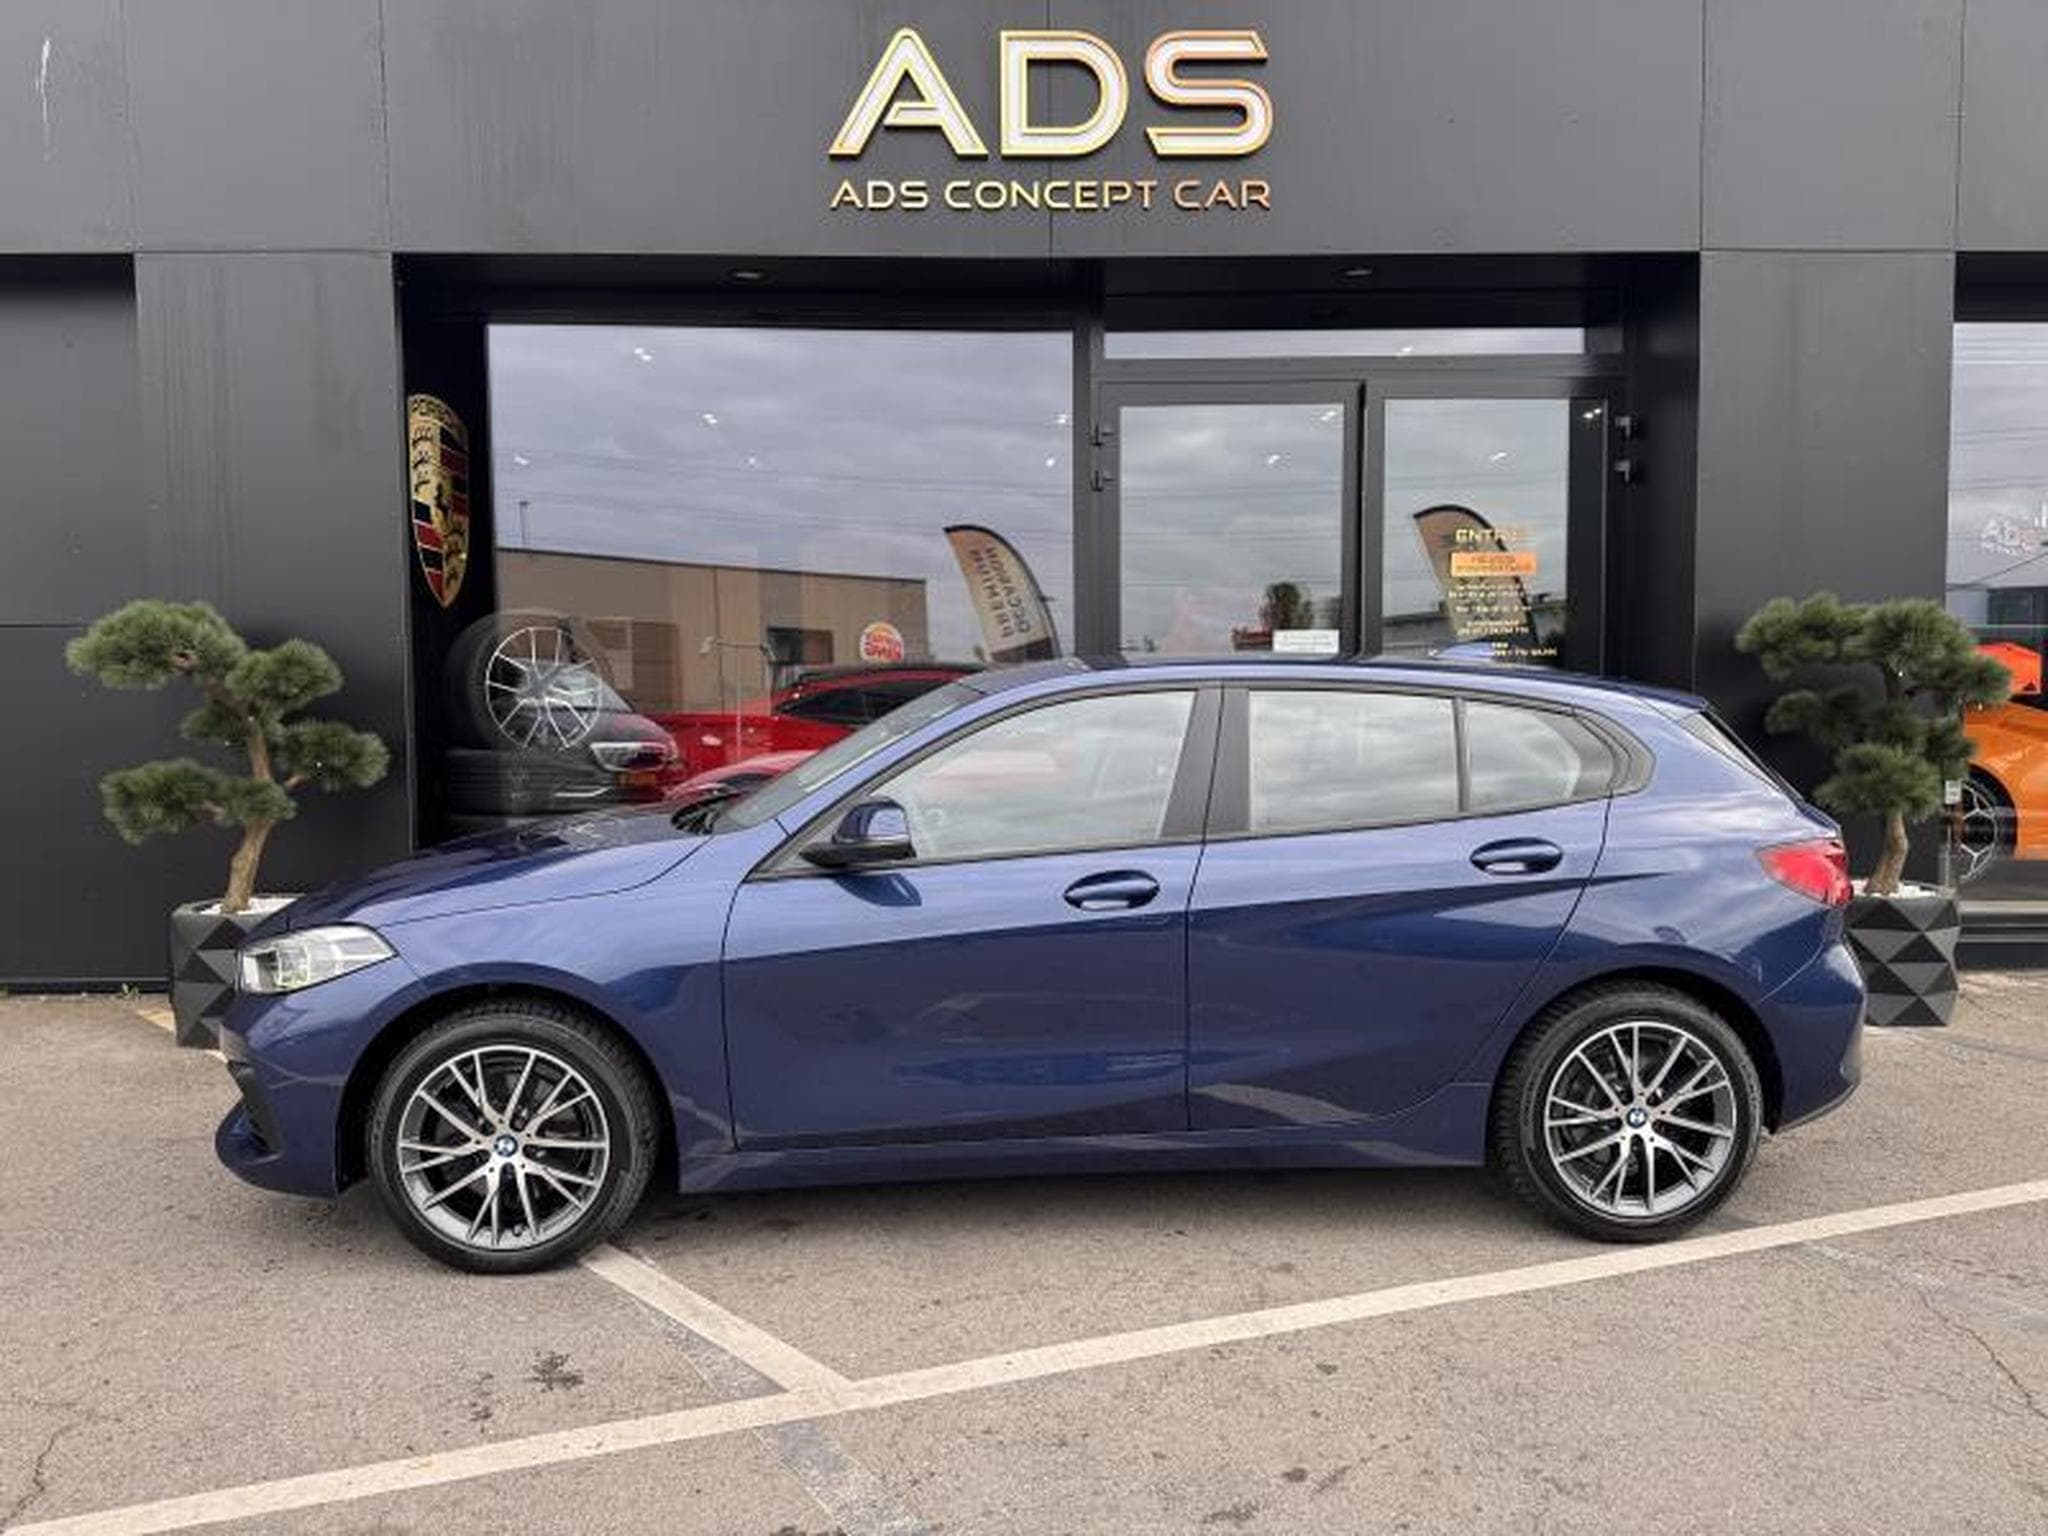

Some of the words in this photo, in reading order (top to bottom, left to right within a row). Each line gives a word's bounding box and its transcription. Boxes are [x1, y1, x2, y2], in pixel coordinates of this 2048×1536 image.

[828, 26, 1274, 157] ADS
[830, 180, 929, 209] ADS
[944, 180, 1158, 209] CONCEPT
[1174, 180, 1272, 209] CAR
